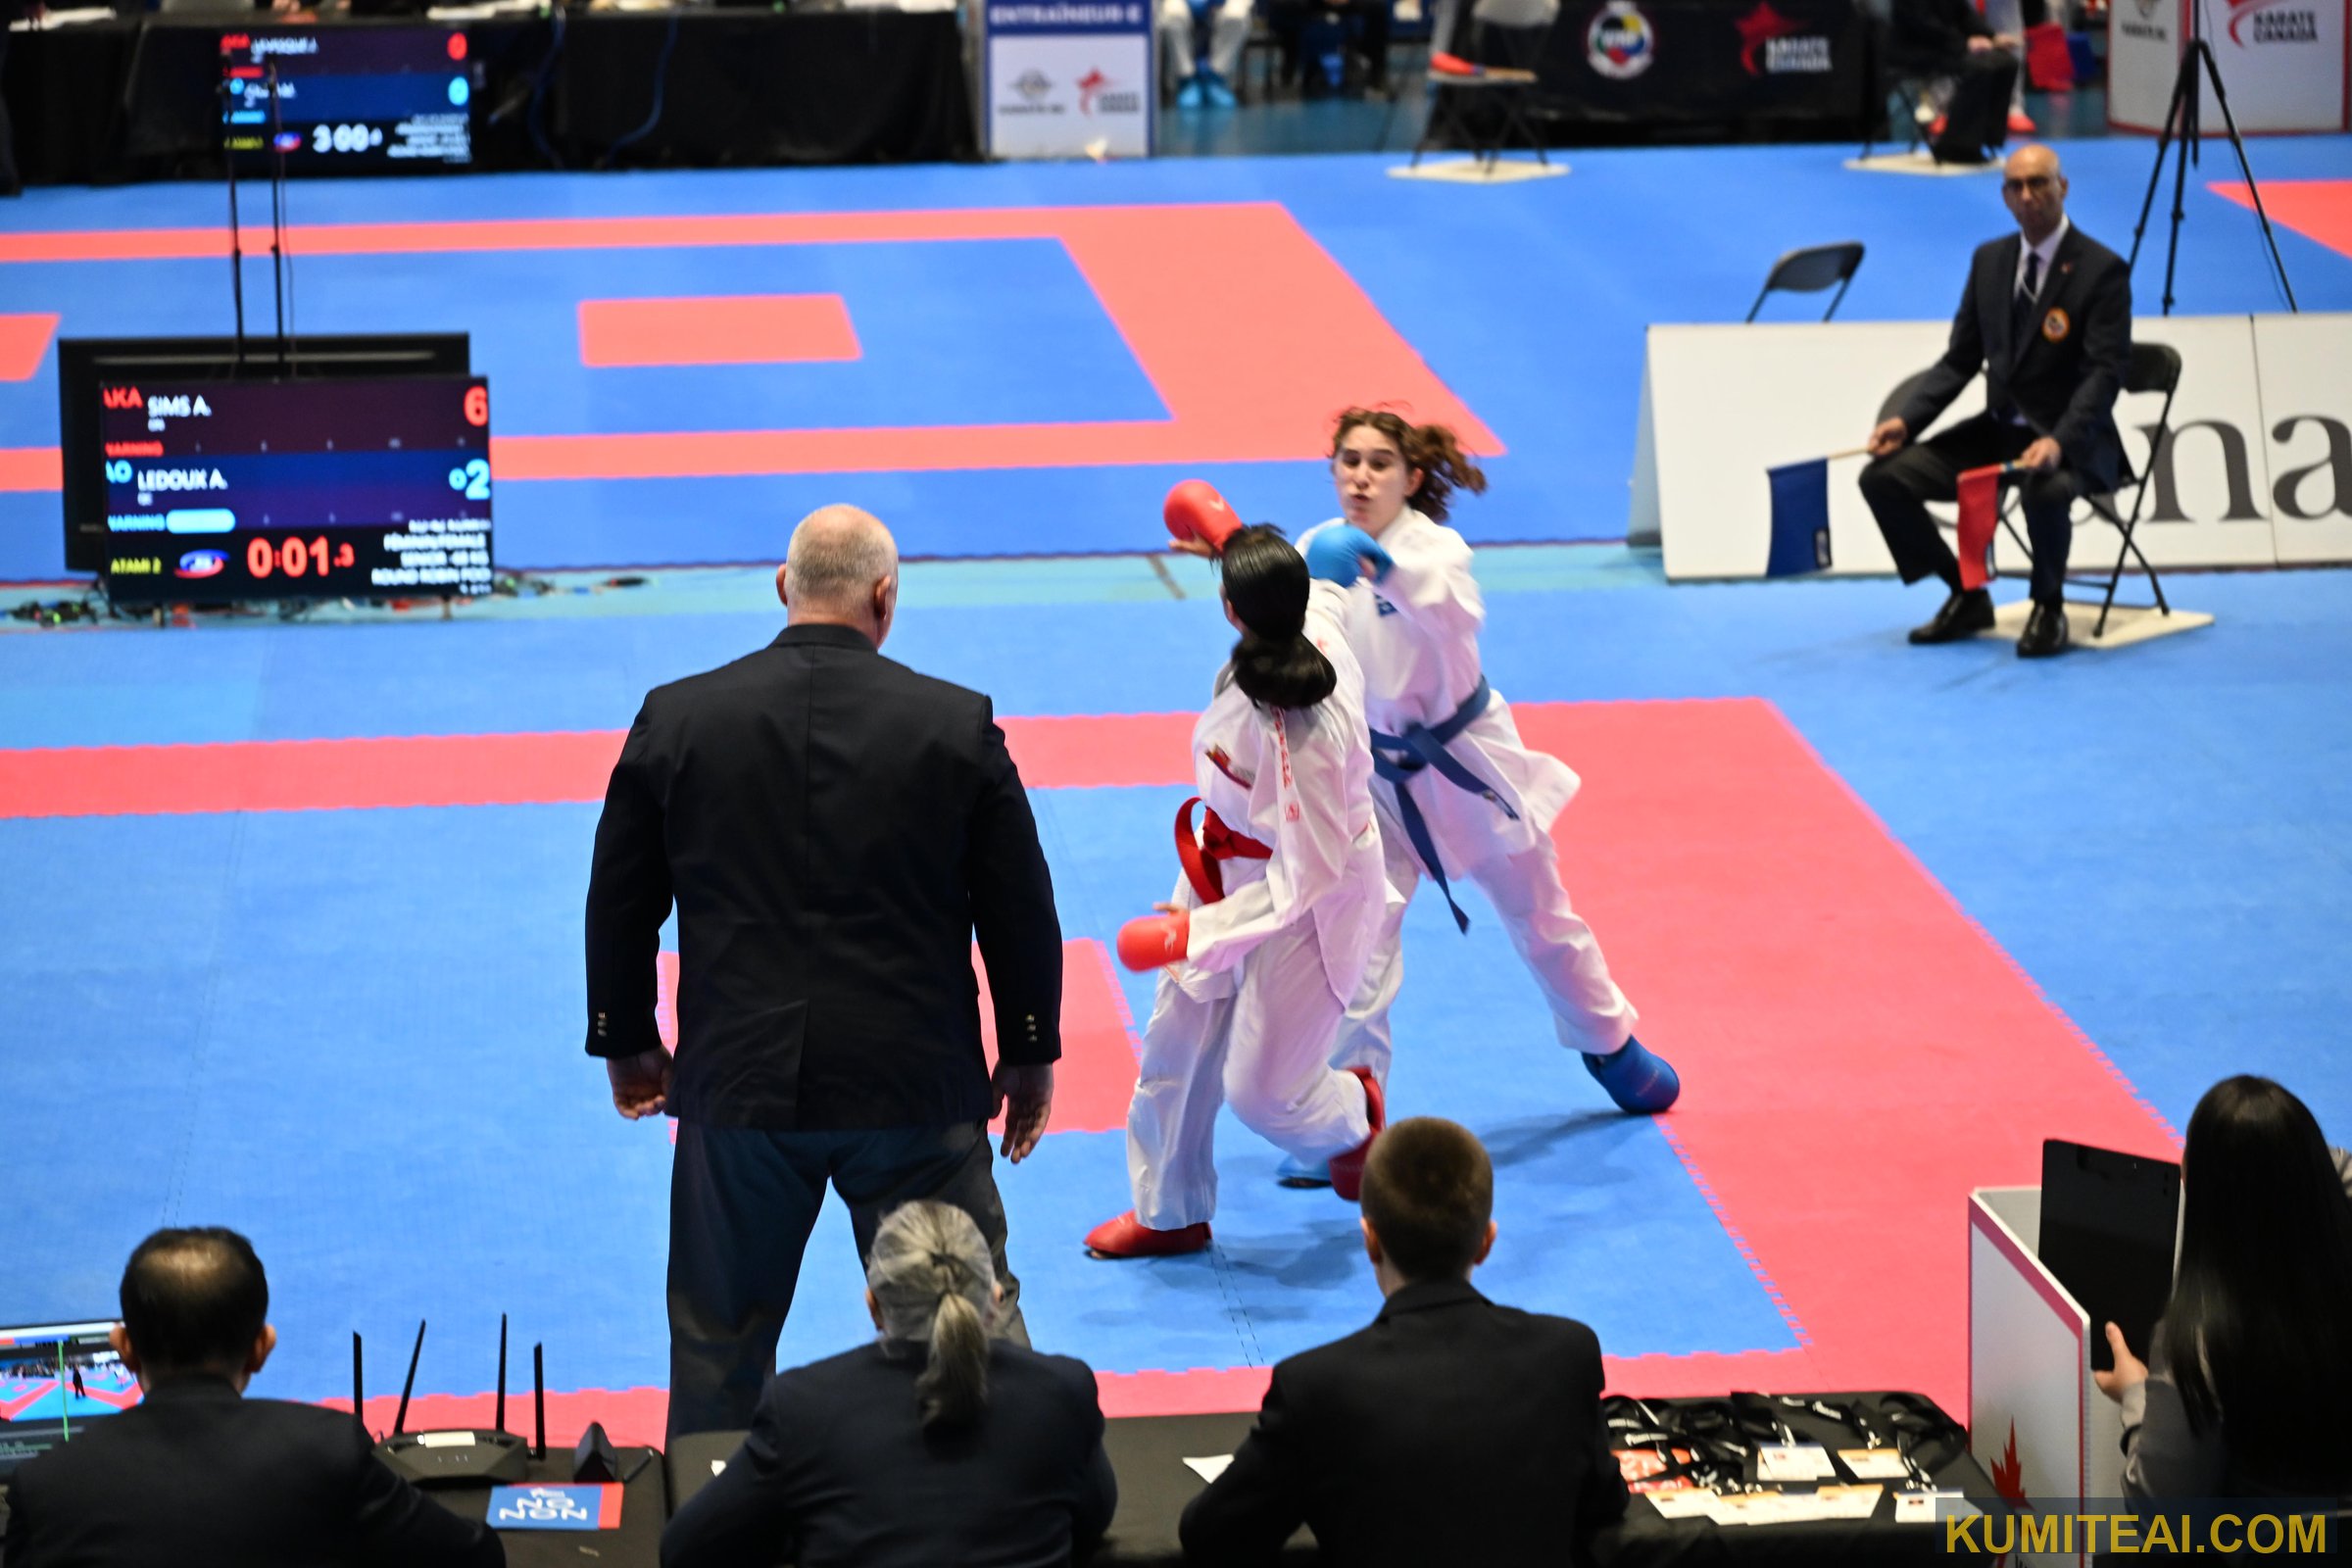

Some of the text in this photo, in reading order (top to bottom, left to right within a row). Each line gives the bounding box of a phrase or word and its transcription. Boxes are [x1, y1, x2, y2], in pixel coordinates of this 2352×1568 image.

[148, 395, 191, 417] SIMS
[193, 395, 213, 417] A.
[465, 385, 488, 426] 6
[137, 468, 208, 491] LEDOUX
[209, 467, 228, 490] A.
[499, 1506, 588, 1521] NON
